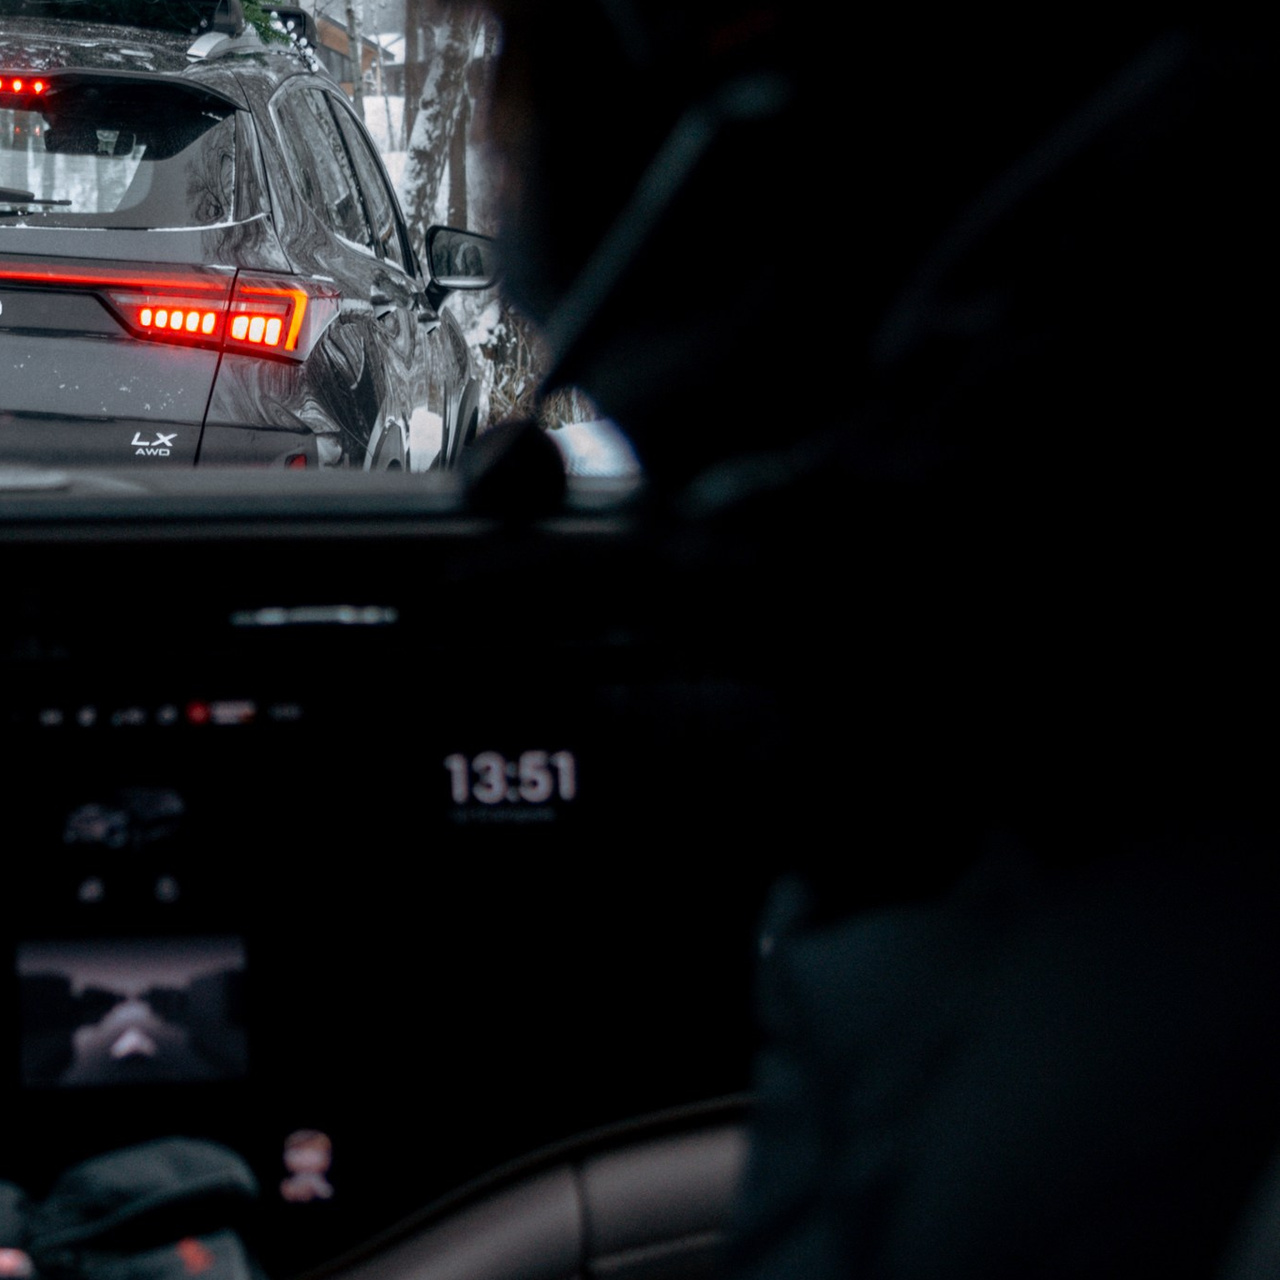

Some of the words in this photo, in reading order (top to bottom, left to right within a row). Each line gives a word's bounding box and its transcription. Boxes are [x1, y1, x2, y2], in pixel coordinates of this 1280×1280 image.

[130, 431, 178, 447] LX
[134, 447, 171, 457] AWD
[443, 748, 577, 805] 13:51
